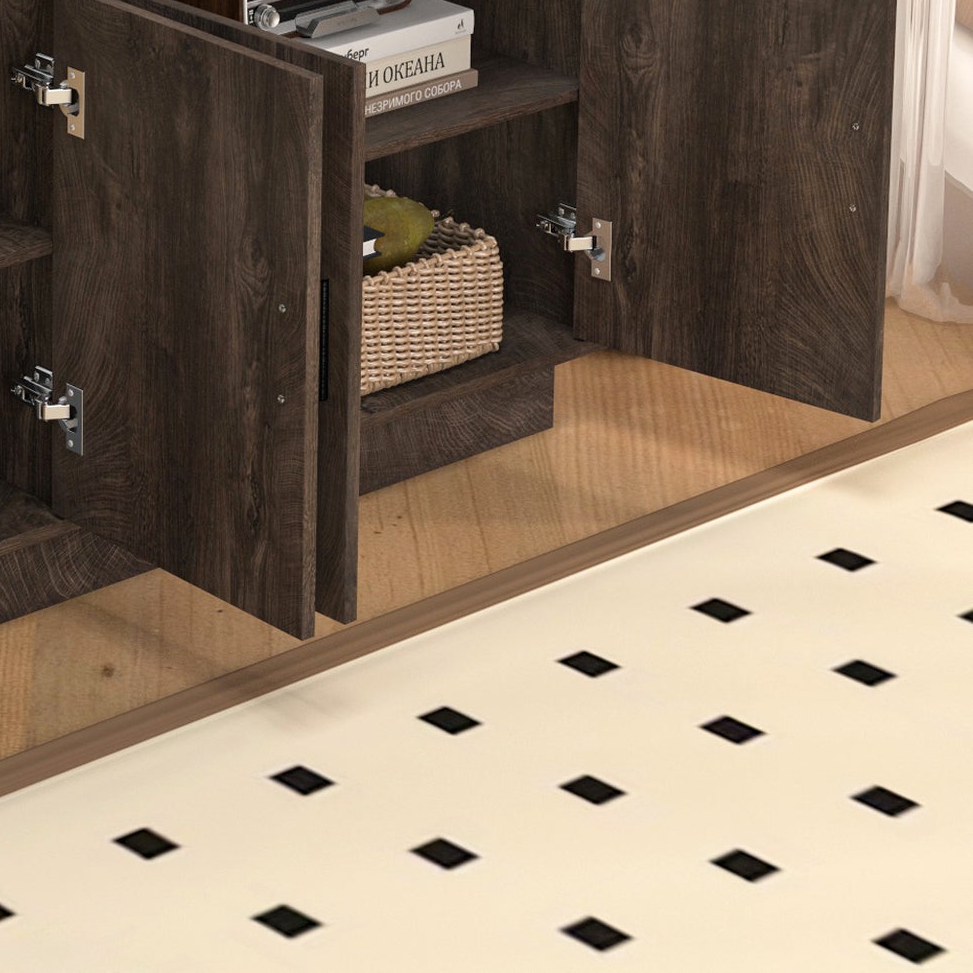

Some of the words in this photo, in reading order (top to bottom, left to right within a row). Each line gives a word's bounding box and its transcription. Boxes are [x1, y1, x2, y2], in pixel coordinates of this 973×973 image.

[344, 47, 369, 61] берг
[383, 52, 445, 84] ОКЕАНА
[364, 90, 423, 116] НЕЗРИМОГО
[424, 79, 462, 99] СОБОРА
